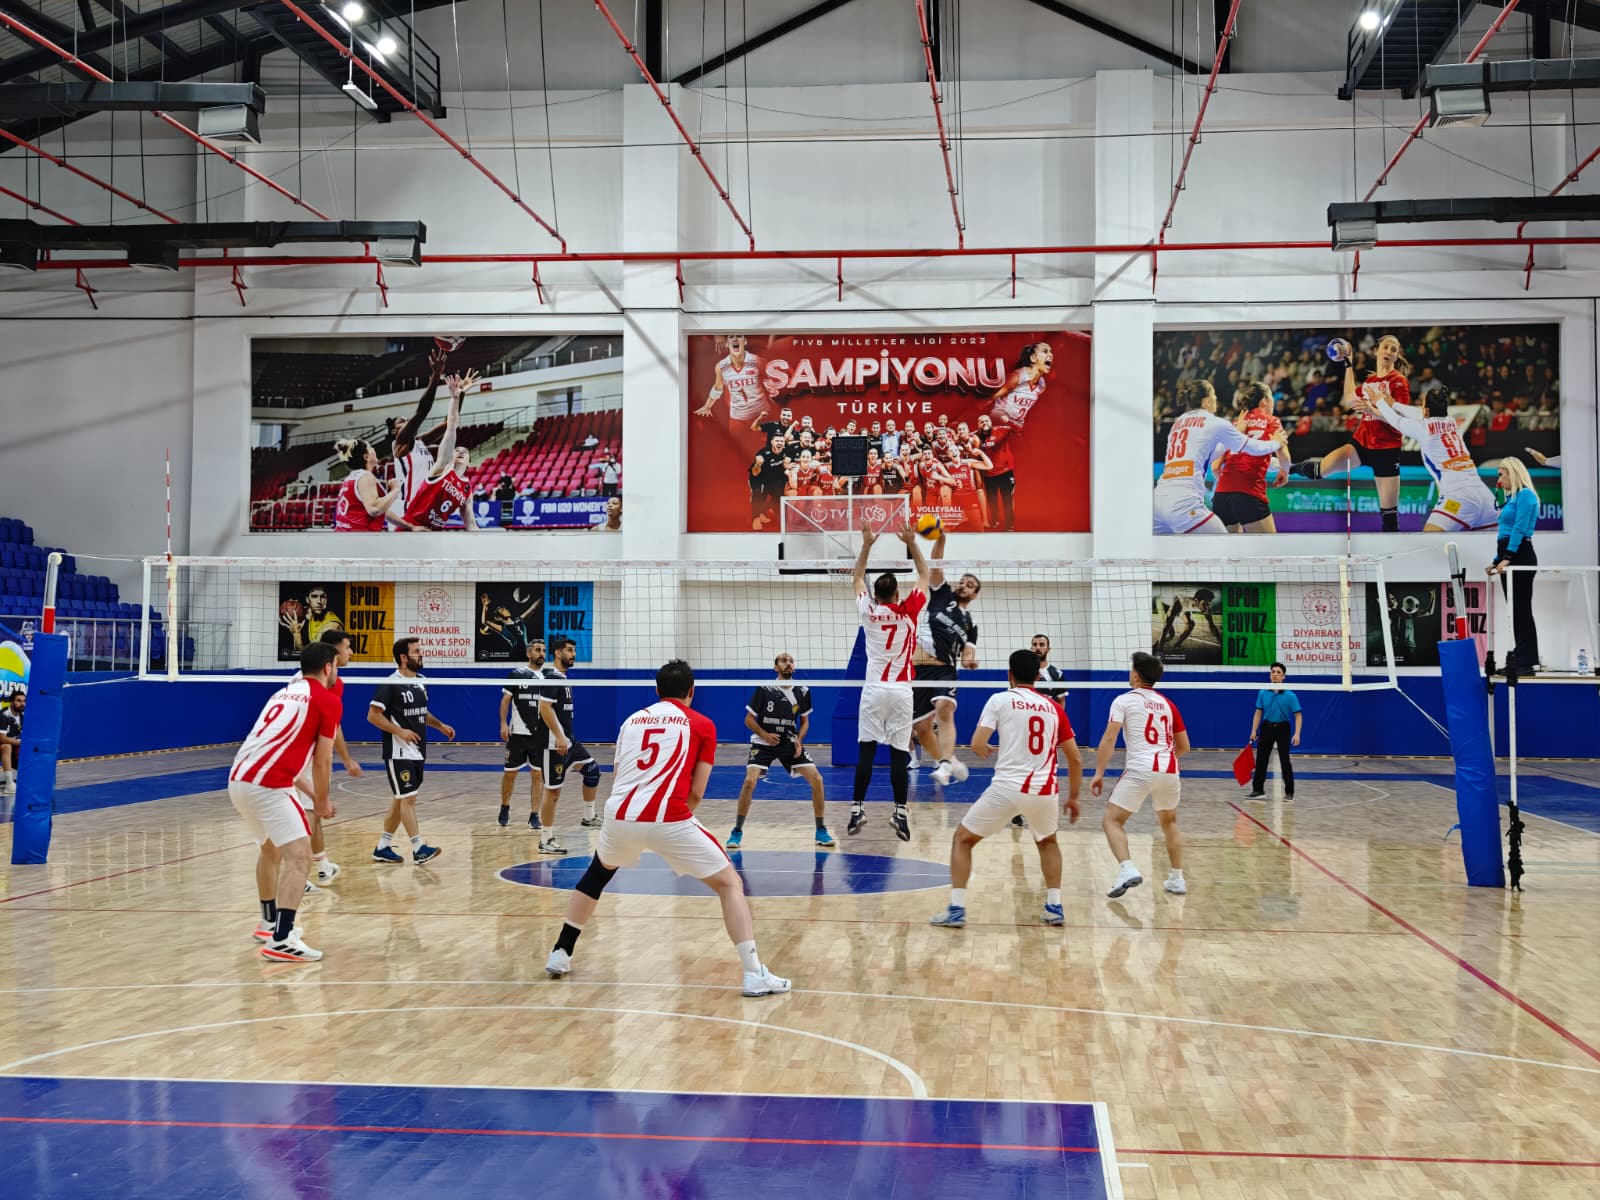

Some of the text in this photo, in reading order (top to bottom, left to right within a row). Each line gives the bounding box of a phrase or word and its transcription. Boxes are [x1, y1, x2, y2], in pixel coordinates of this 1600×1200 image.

[950, 337, 987, 345] 2023
[763, 349, 1006, 397] ŞAMPİYONU
[837, 400, 933, 414] TÜRKİYE
[1168, 429, 1189, 461] 33
[441, 500, 452, 512] 6
[350, 586, 380, 606] SPOR
[550, 586, 580, 606] SPOR
[1228, 587, 1260, 608] SPOR
[946, 600, 958, 612] 2
[409, 626, 460, 634] DİYARBAKIR
[881, 624, 898, 650] 7
[436, 638, 446, 646] VE
[448, 638, 471, 646] SPOR
[1228, 636, 1248, 659] BİZ
[1286, 654, 1294, 662] İL
[401, 690, 414, 703] 10
[766, 701, 774, 712] 8
[1012, 698, 1057, 715] İSMAİL
[256, 704, 285, 738] 9
[631, 716, 689, 726] YUNUS EMRE
[1144, 713, 1172, 746] 61
[1028, 716, 1045, 756] 8
[636, 728, 666, 770] 5
